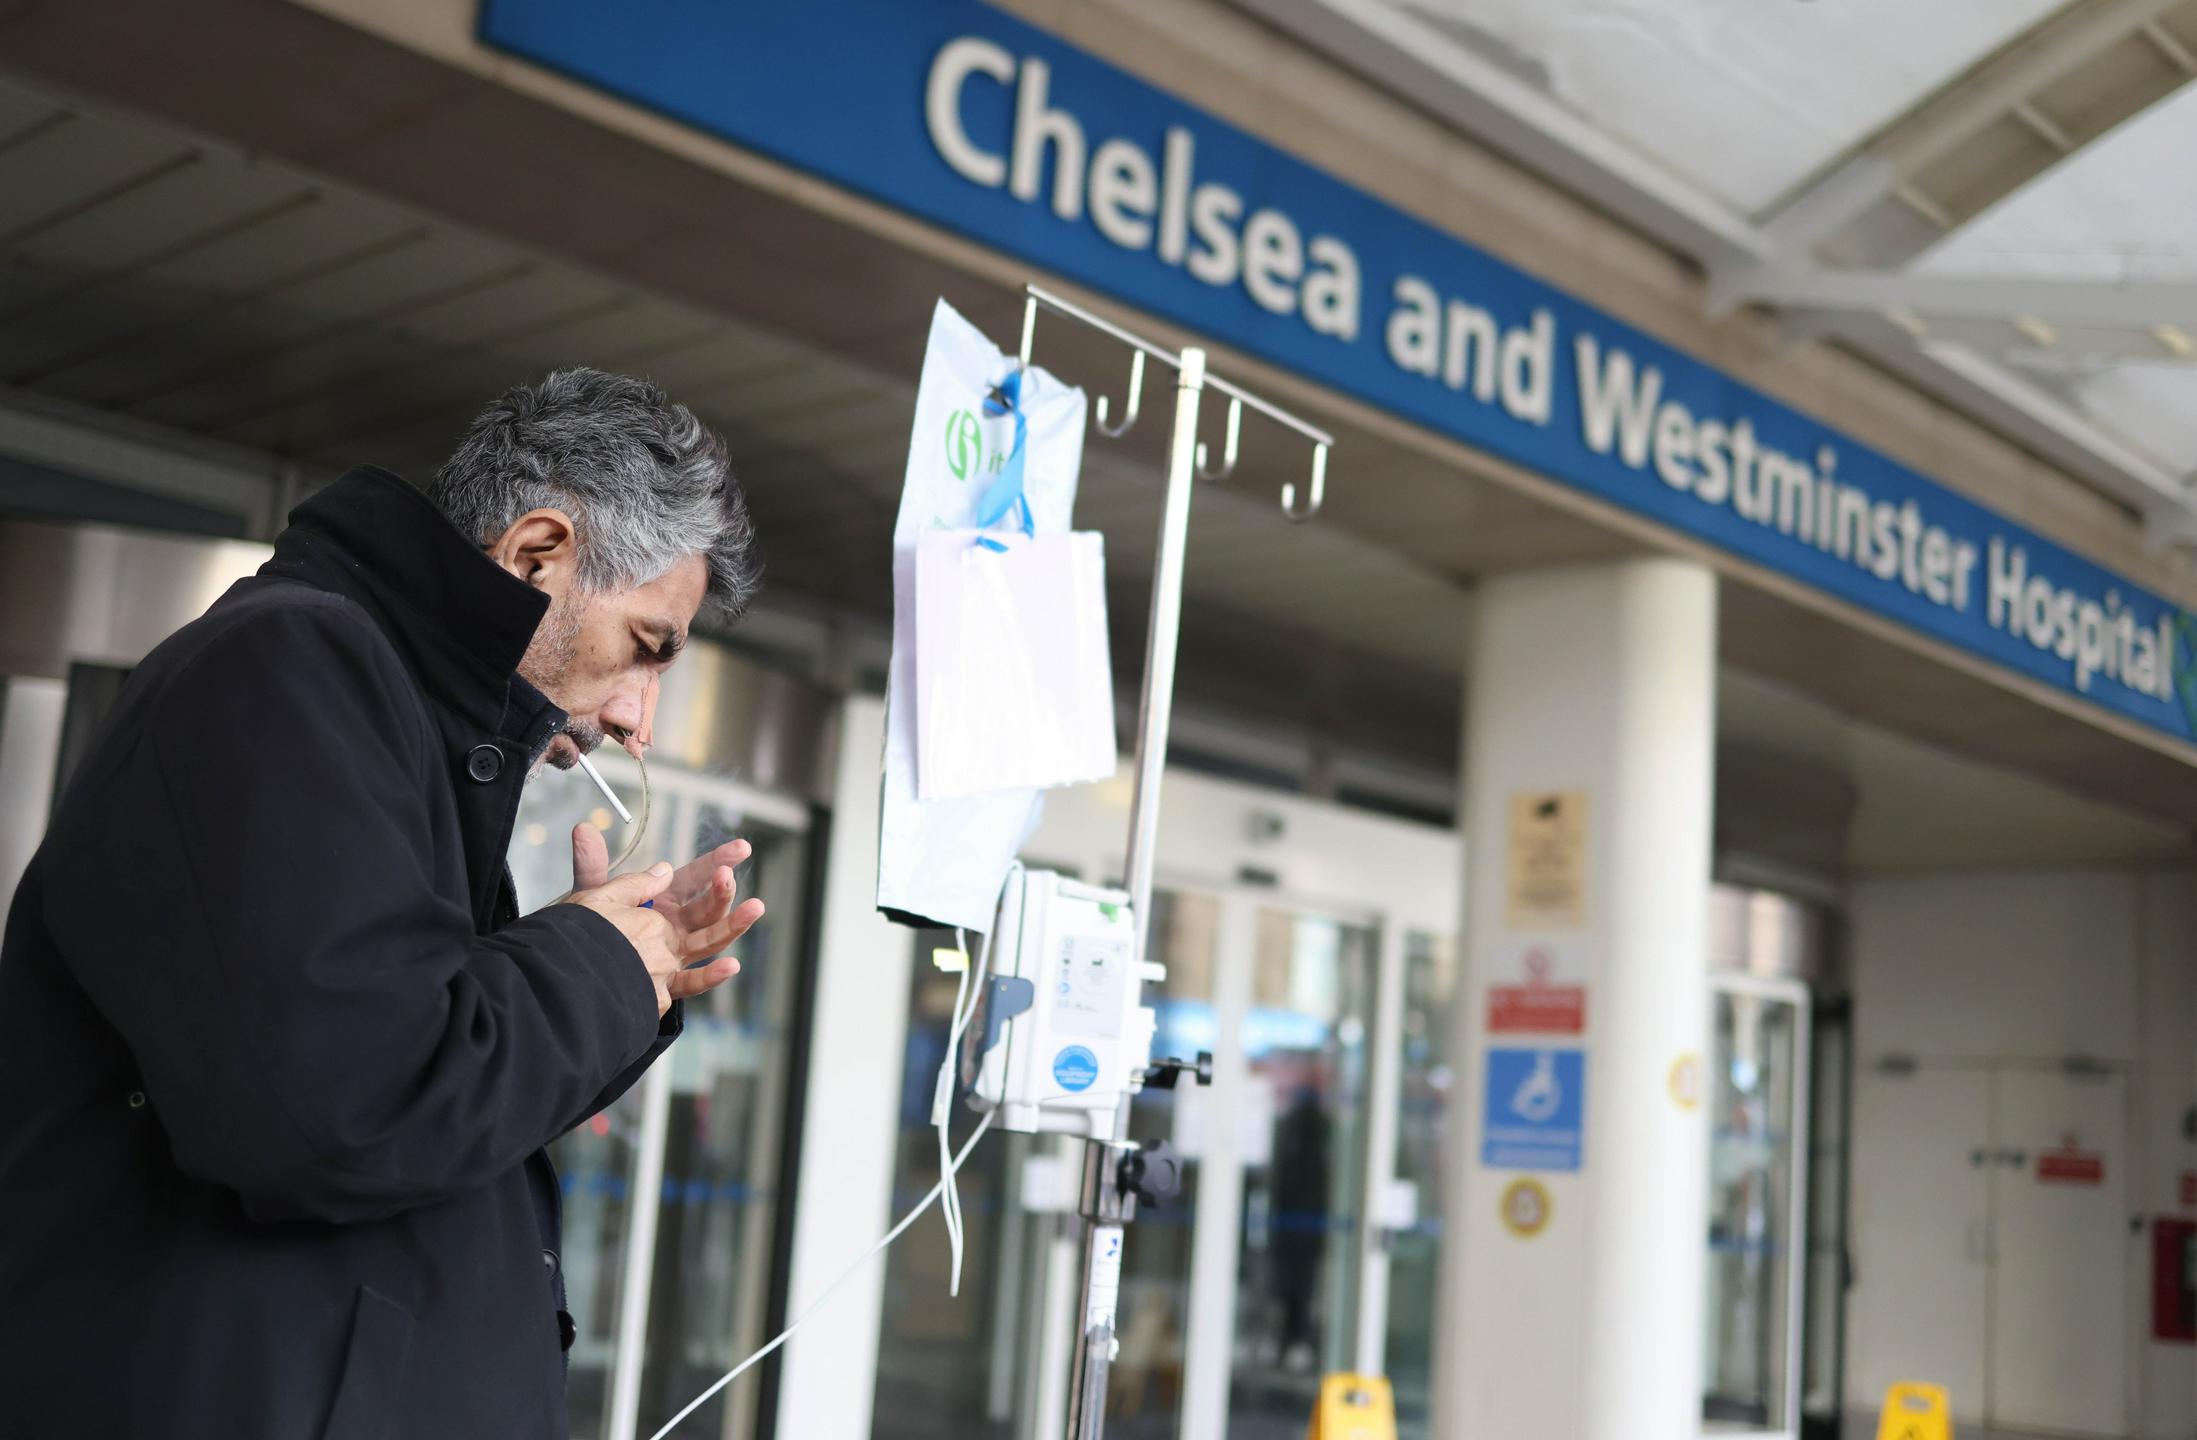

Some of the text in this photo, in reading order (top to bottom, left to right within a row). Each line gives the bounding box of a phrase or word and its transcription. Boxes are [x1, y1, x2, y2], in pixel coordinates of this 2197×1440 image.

[926, 38, 2171, 701] Chelsea and Westminster Hospital
